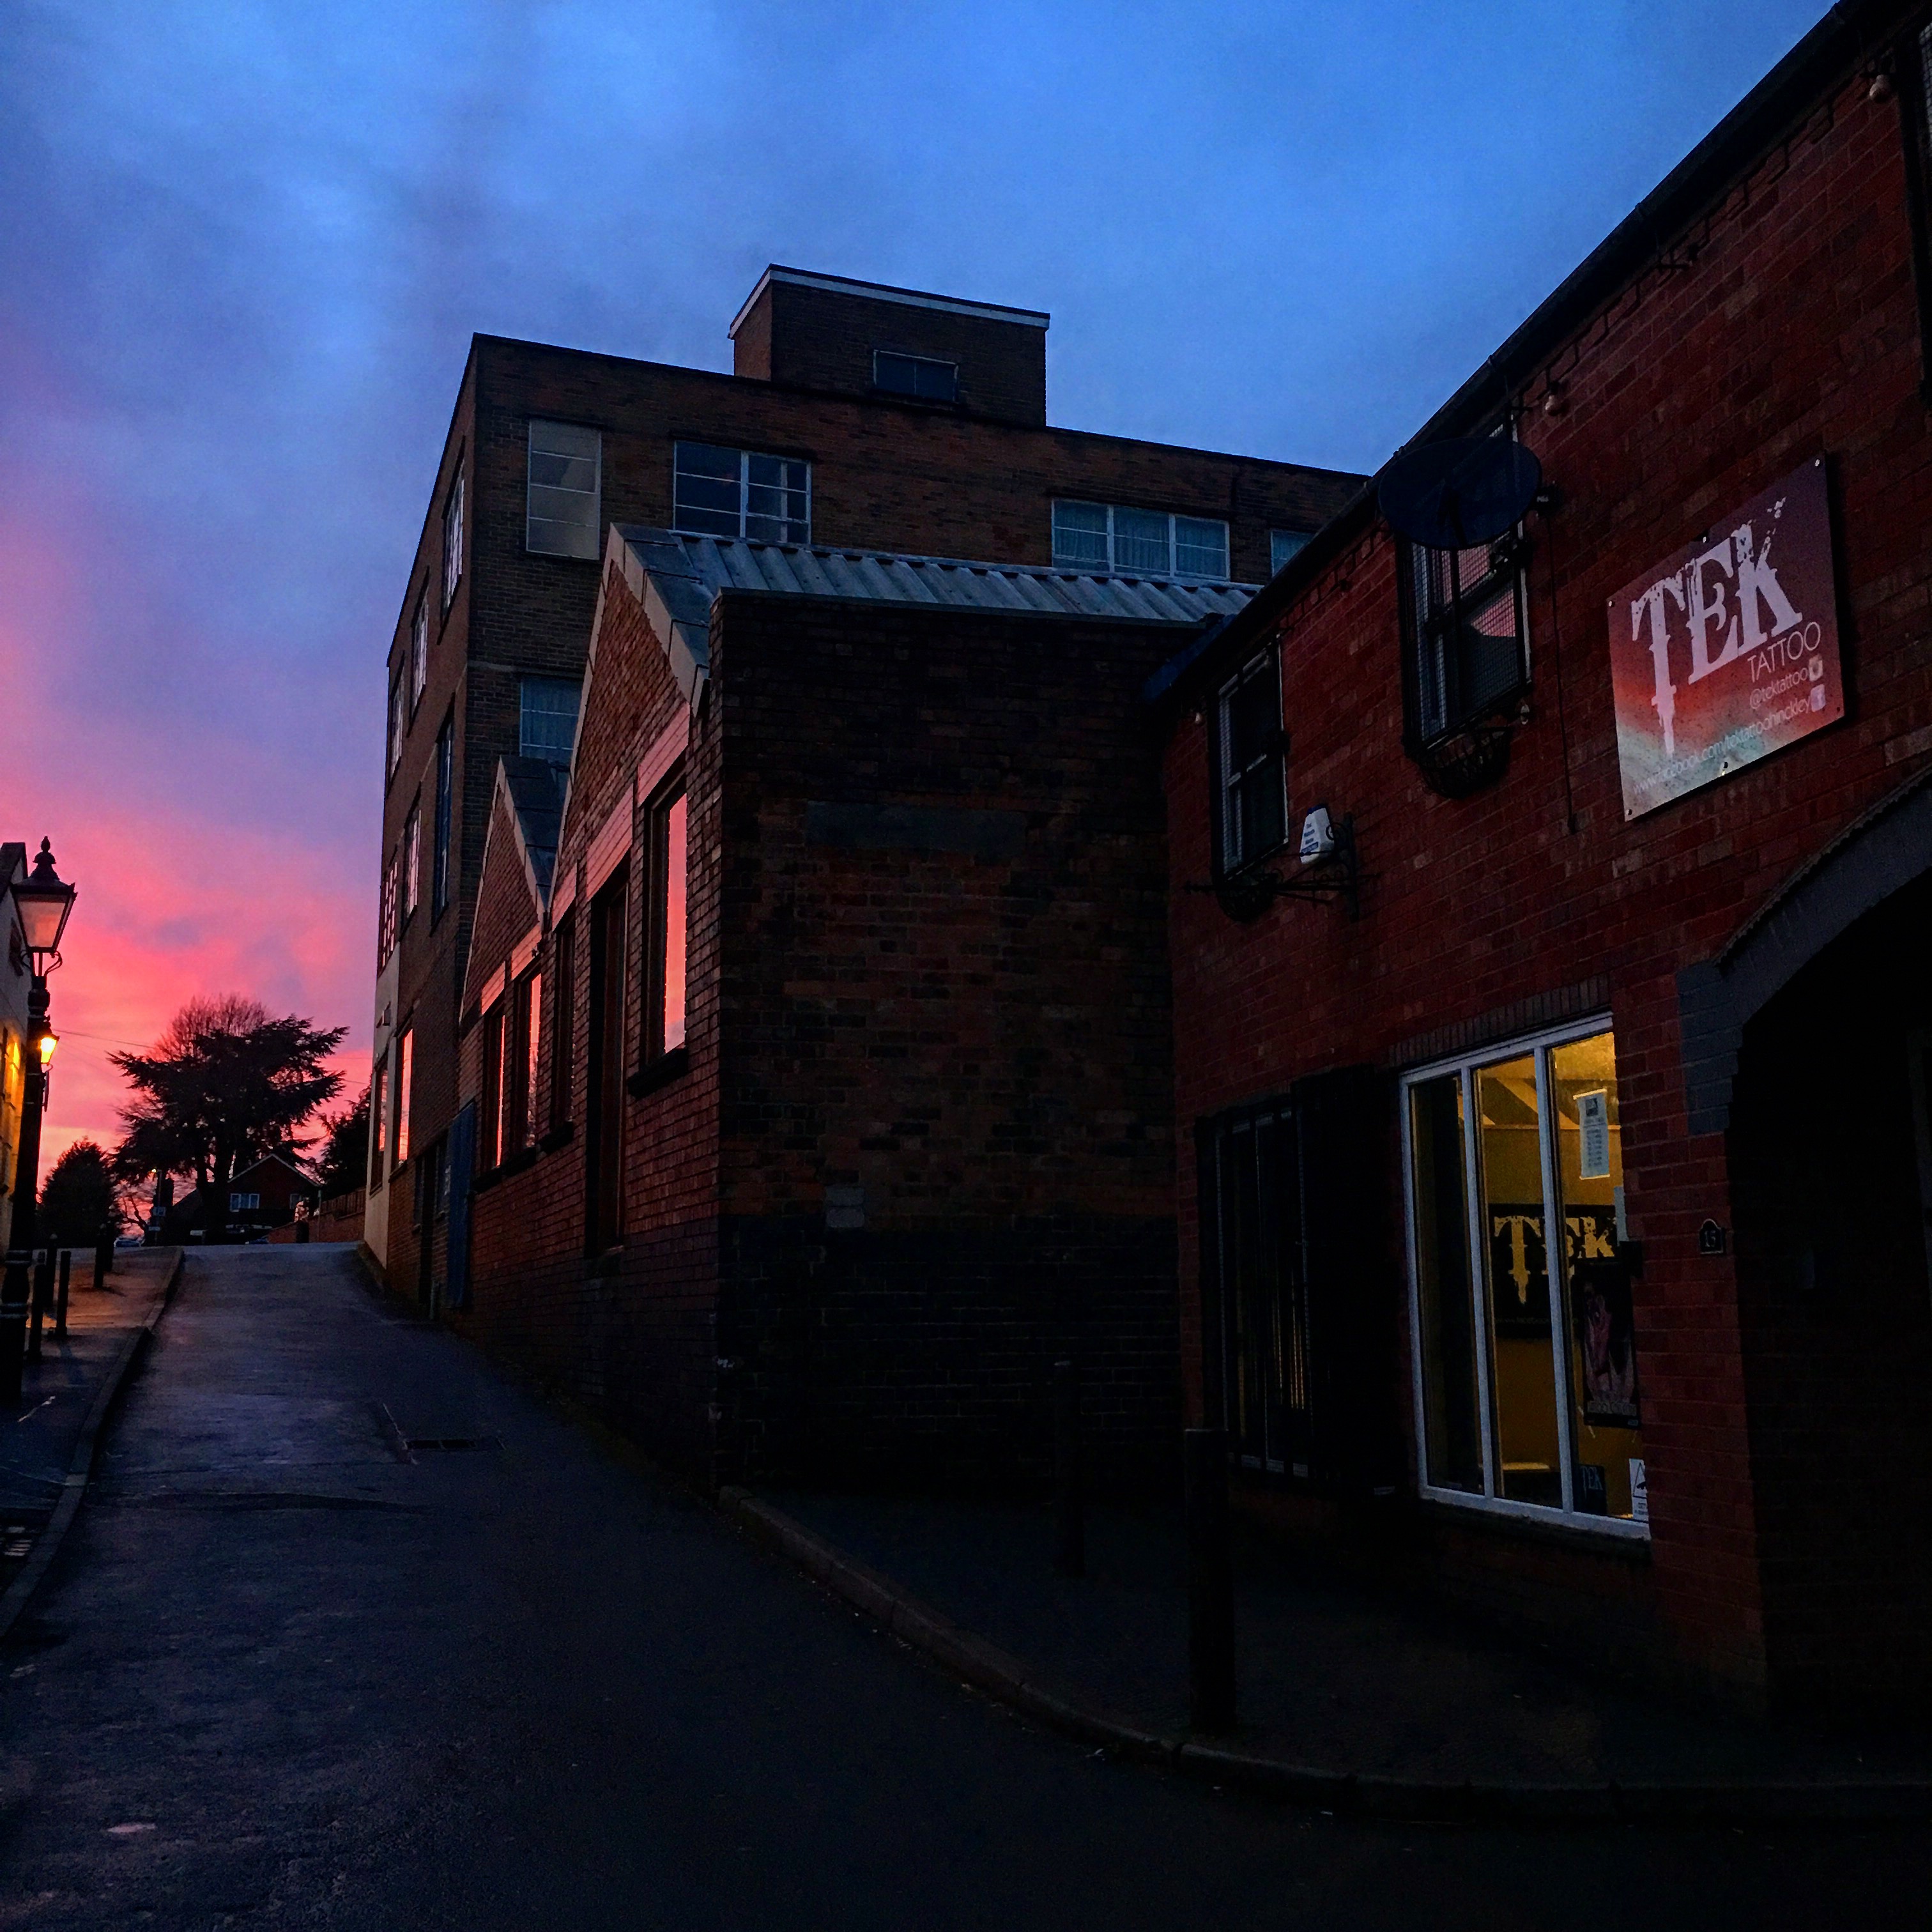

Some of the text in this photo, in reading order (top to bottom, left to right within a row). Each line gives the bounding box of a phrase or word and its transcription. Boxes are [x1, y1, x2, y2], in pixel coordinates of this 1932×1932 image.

[1630, 497, 1803, 755] TEK
[1747, 621, 1821, 684] TATTOO
[1750, 667, 1808, 709] @tektattoo
